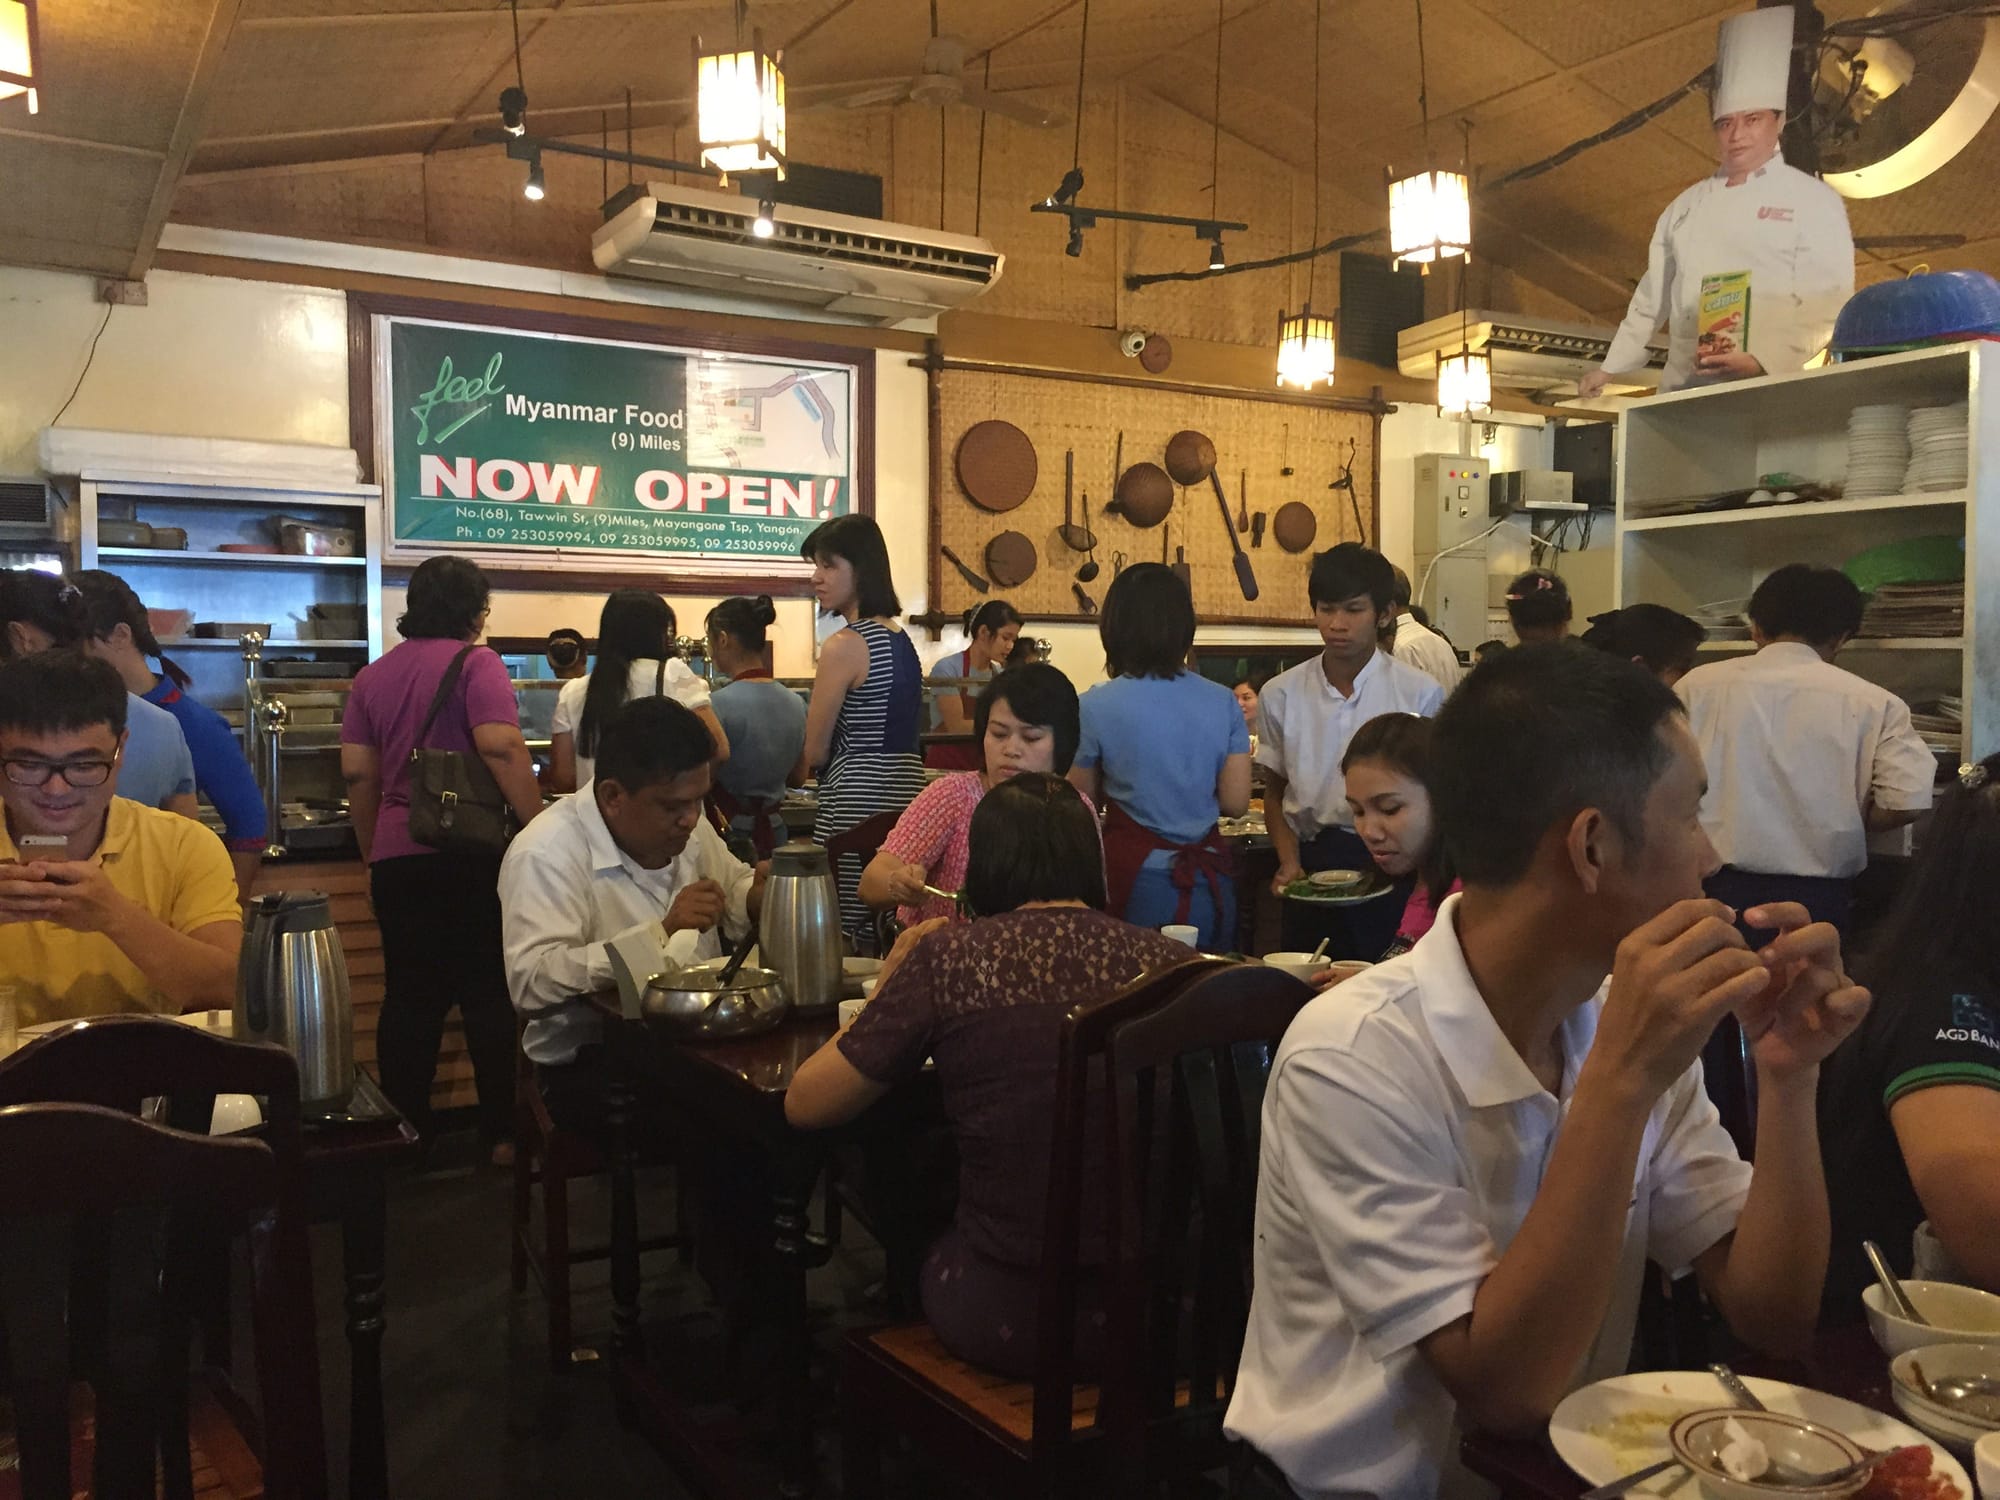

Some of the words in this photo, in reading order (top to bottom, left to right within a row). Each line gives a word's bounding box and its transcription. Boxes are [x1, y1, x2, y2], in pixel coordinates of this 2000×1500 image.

[410, 352, 506, 445] feel
[505, 393, 618, 423] Myanmar
[625, 404, 683, 429] Food
[611, 432, 635, 451] (9)
[640, 434, 681, 451] Miles
[420, 454, 600, 504] NOW
[634, 469, 840, 519] OPEN!
[455, 507, 513, 522] No.(68),
[518, 509, 568, 523] Tawwin
[572, 513, 589, 525] St,
[593, 514, 649, 529] (9)Miles,
[653, 518, 726, 532] Mayangone
[730, 521, 752, 533] Tsp,
[456, 526, 472, 537] Ph
[487, 528, 505, 539] 09
[511, 529, 595, 544] 253059994,
[599, 532, 617, 544] 09
[622, 534, 700, 549] 253059995,
[704, 538, 721, 549] 09
[725, 539, 796, 552] 253059996
[1971, 1029, 2000, 1051] BAN
